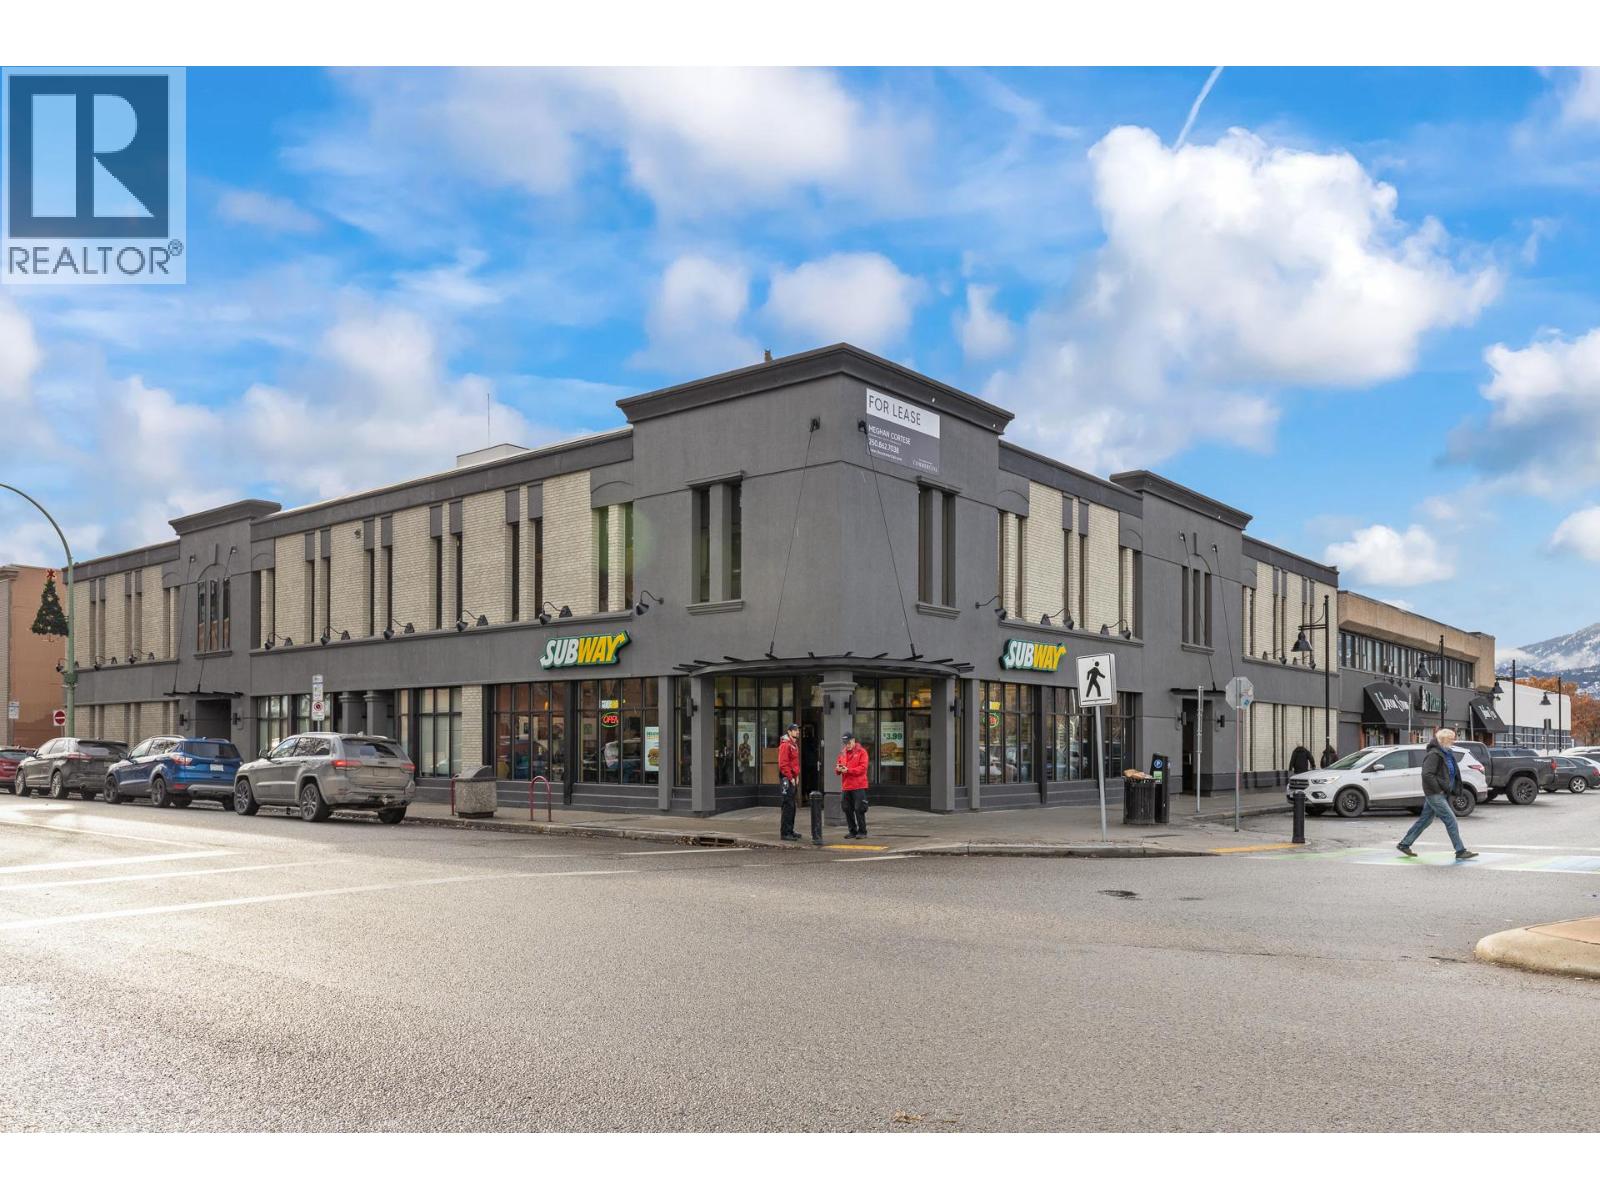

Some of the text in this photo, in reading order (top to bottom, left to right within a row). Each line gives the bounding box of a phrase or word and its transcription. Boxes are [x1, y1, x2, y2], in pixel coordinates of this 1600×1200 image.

[869, 395, 921, 426] FOR LEASE
[868, 424, 890, 438] MEGHAN
[890, 432, 911, 445] CORTESE
[540, 632, 627, 667] SUBWAY
[1004, 640, 1067, 671] SUBWAY
